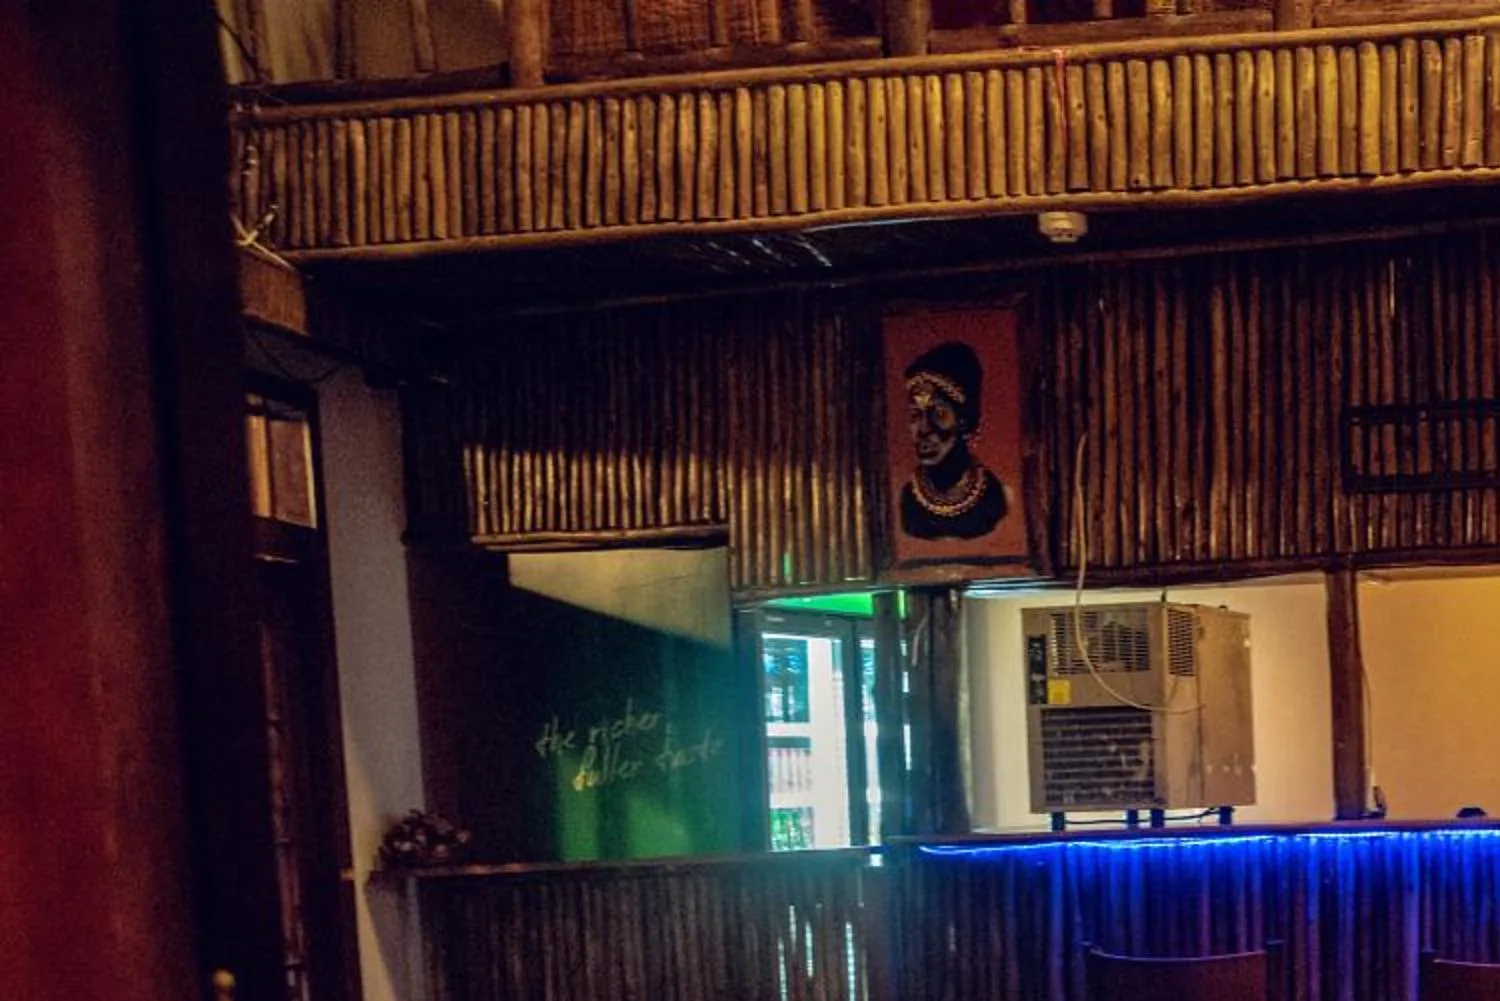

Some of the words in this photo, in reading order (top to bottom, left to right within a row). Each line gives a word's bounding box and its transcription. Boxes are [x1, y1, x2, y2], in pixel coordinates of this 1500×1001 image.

[535, 715, 576, 757] the
[589, 697, 661, 742] richer
[572, 743, 643, 791] fuller
